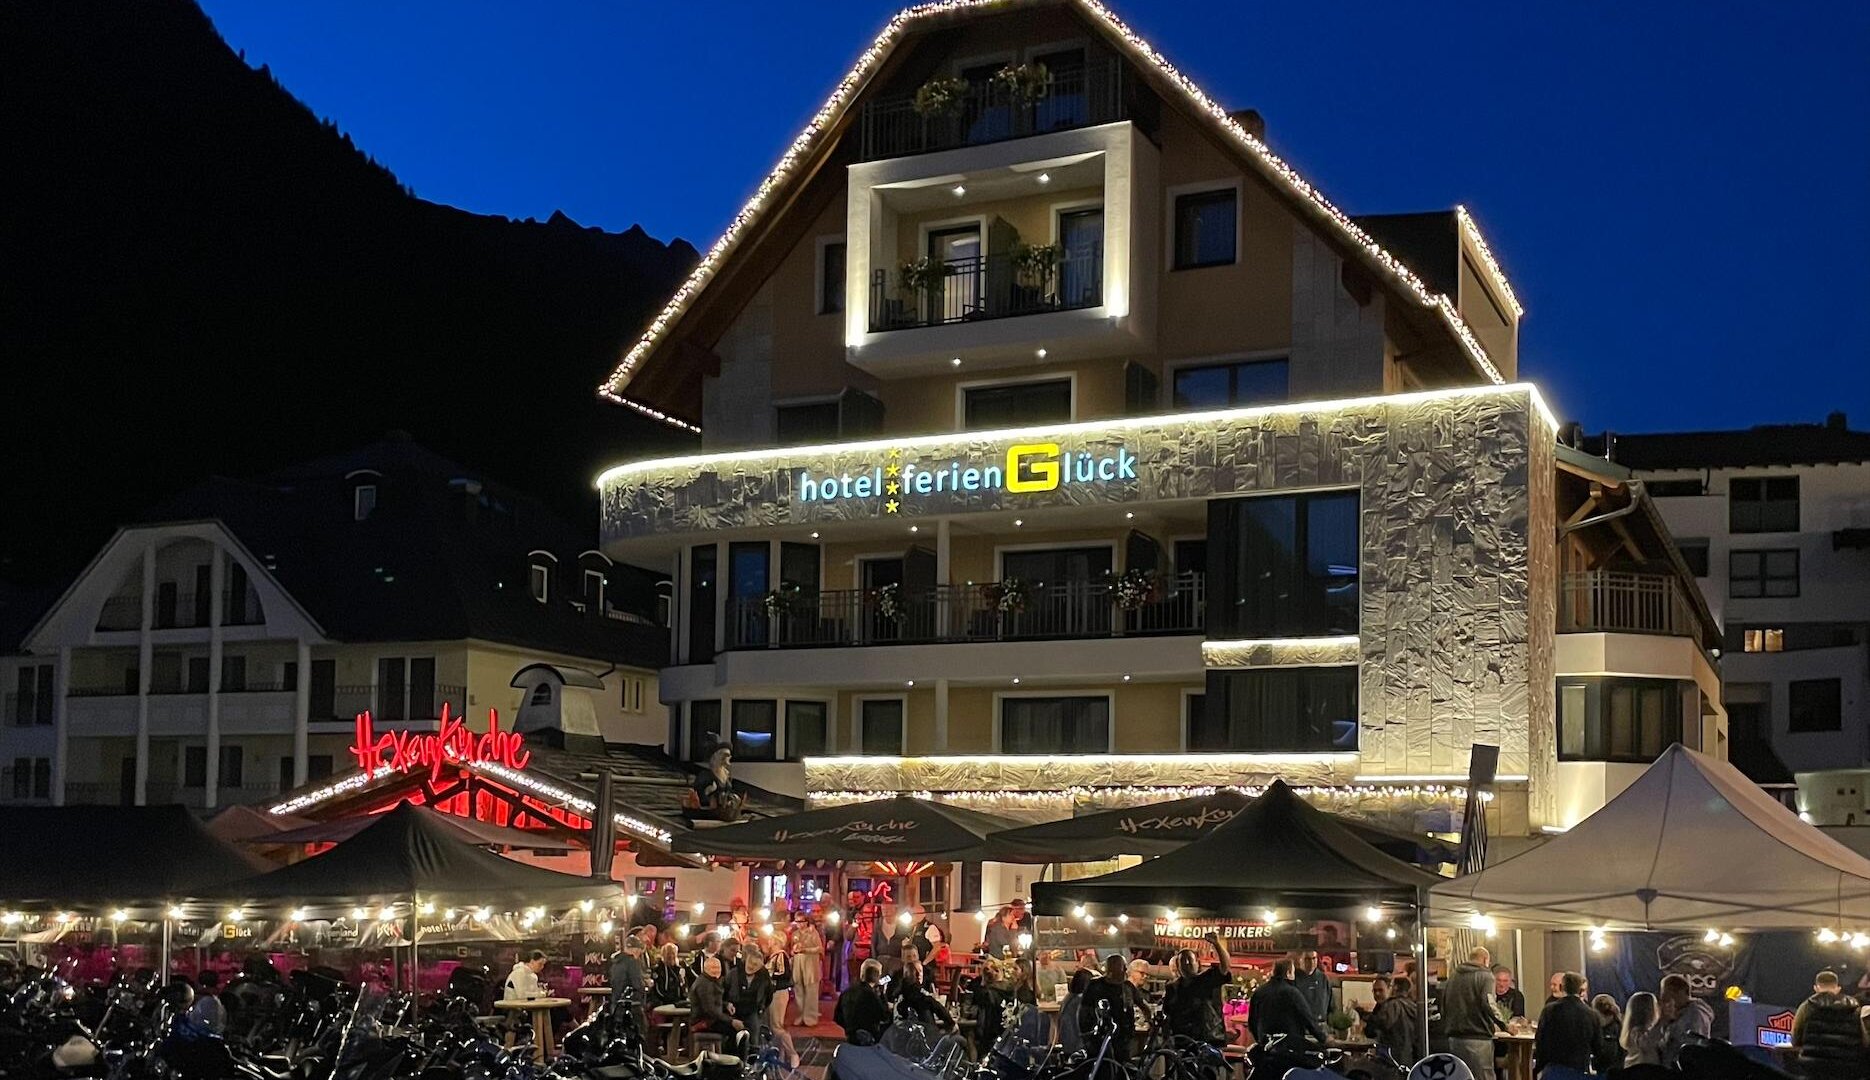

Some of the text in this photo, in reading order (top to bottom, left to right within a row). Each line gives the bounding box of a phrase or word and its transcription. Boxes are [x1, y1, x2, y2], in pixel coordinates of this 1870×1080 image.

[800, 442, 1137, 502] hotel ferienGlück
[1223, 925, 1273, 938] BIKERS
